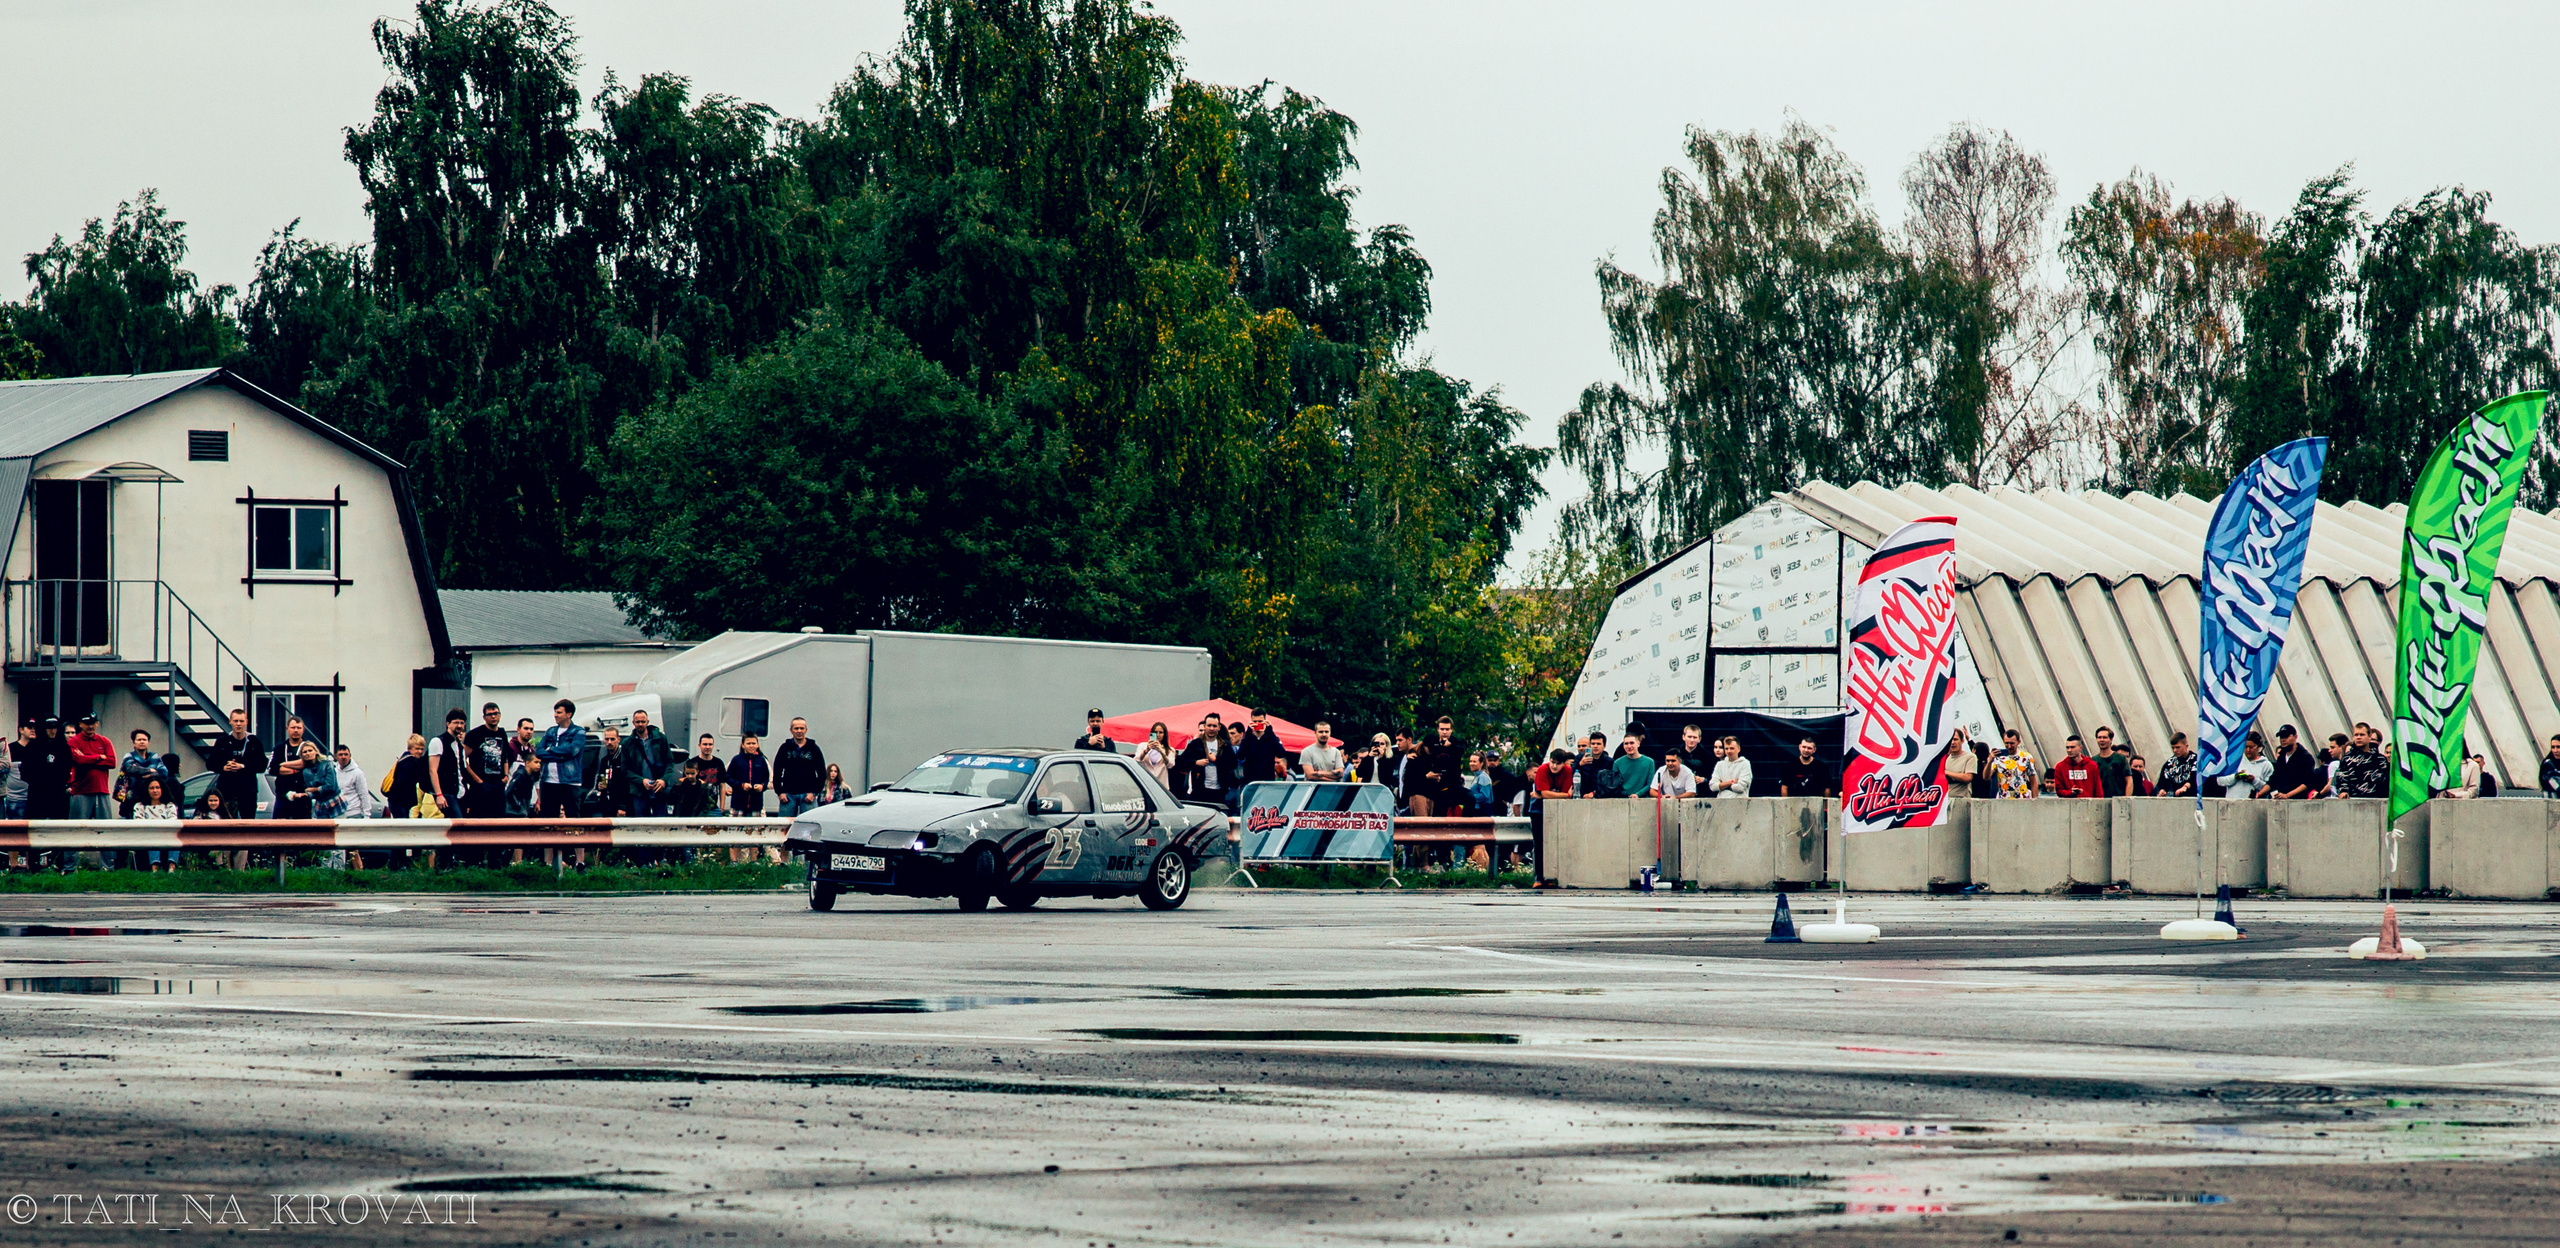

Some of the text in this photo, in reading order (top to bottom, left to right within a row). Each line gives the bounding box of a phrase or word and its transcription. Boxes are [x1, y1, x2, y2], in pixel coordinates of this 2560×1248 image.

[1293, 817, 1388, 830] АВТОМОБИЛЕЙ ВАЗ
[1045, 828, 1083, 869] 23
